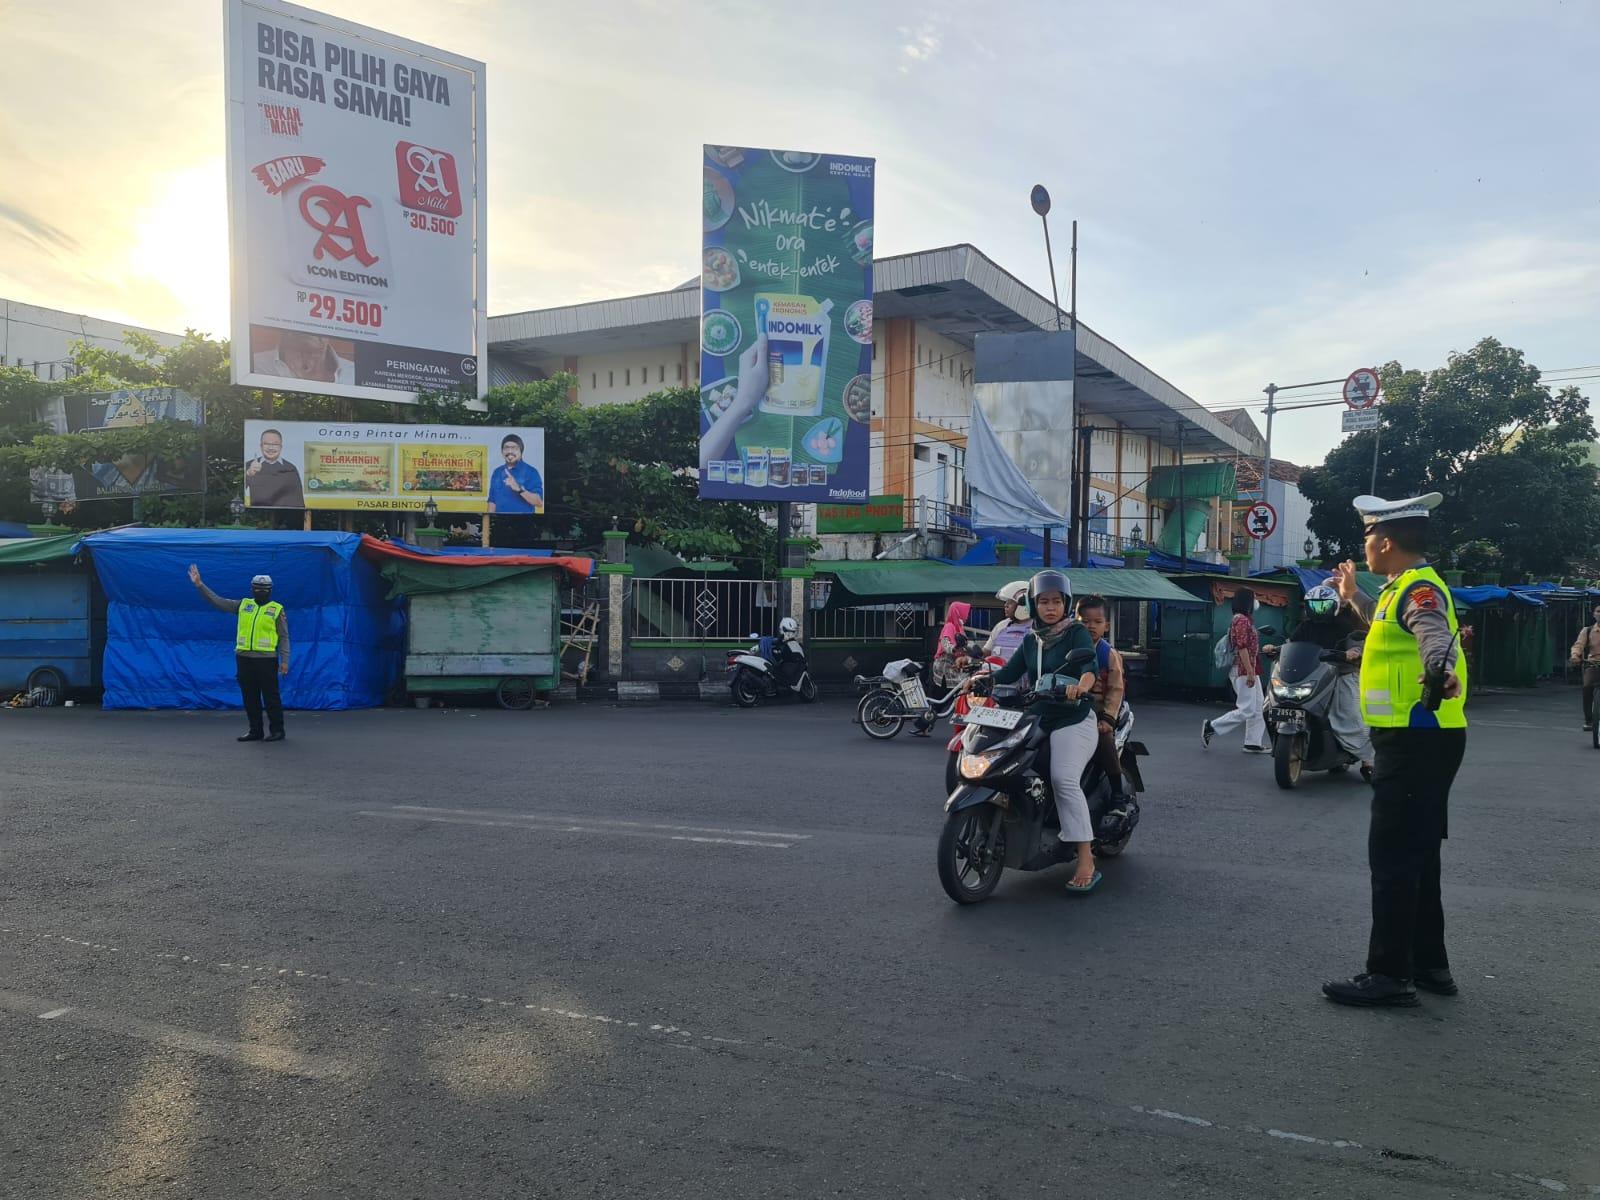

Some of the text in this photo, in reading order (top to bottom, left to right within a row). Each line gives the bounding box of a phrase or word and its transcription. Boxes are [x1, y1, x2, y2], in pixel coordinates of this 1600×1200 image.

[257, 22, 450, 106] BISA PILIH GAYA
[257, 57, 411, 127] RASA SAMA!
[264, 156, 305, 188] BARU
[830, 162, 872, 173] INDOMILK
[417, 197, 448, 209] Mild
[776, 234, 806, 251] ora
[307, 264, 389, 289] ICON EDITION
[769, 320, 822, 335] INDOMILK
[386, 360, 450, 375] PERINGATAN:
[91, 397, 131, 406] Sarung
[318, 428, 472, 439] Orang Pintar Minum...
[829, 488, 866, 498] Indofood
[357, 499, 389, 509] PASAR
